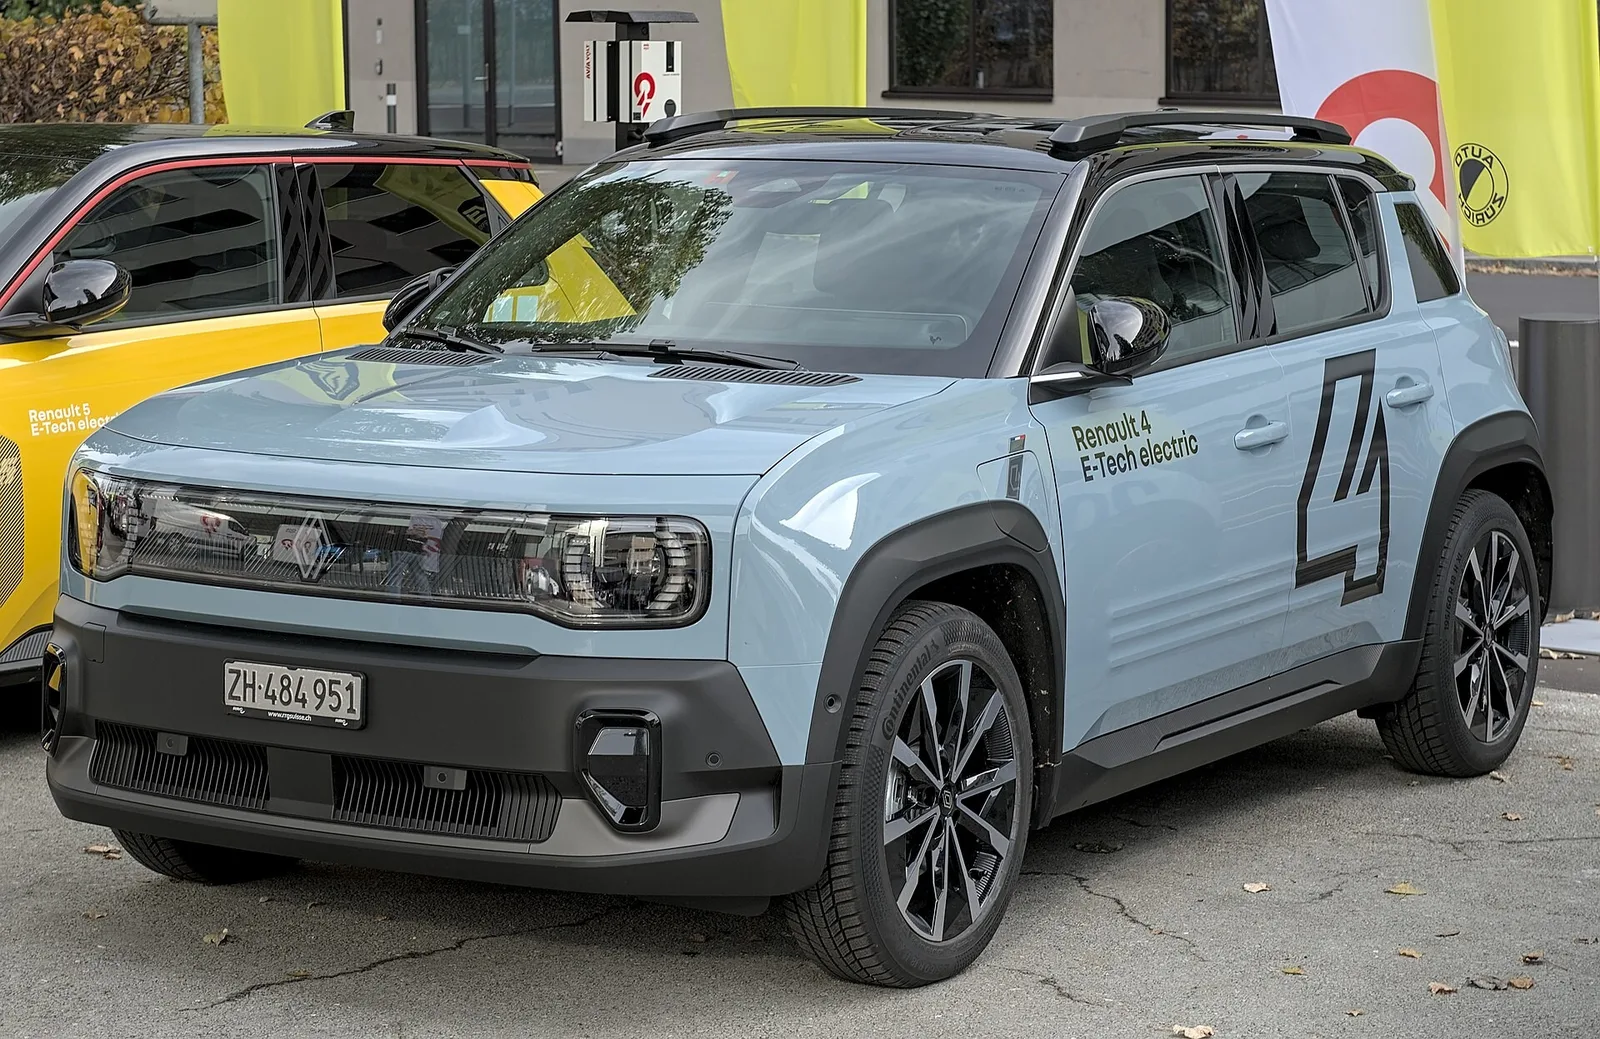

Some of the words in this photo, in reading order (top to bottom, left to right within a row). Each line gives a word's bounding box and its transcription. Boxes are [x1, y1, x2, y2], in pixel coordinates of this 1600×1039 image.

[28, 403, 82, 423] Renault
[82, 403, 91, 415] 5
[31, 418, 76, 436] E-Tech
[1071, 412, 1140, 451] Renault
[1140, 410, 1151, 434] 4
[1080, 444, 1138, 483] E-Tech
[1139, 429, 1199, 467] electric
[882, 646, 933, 741] Continental
